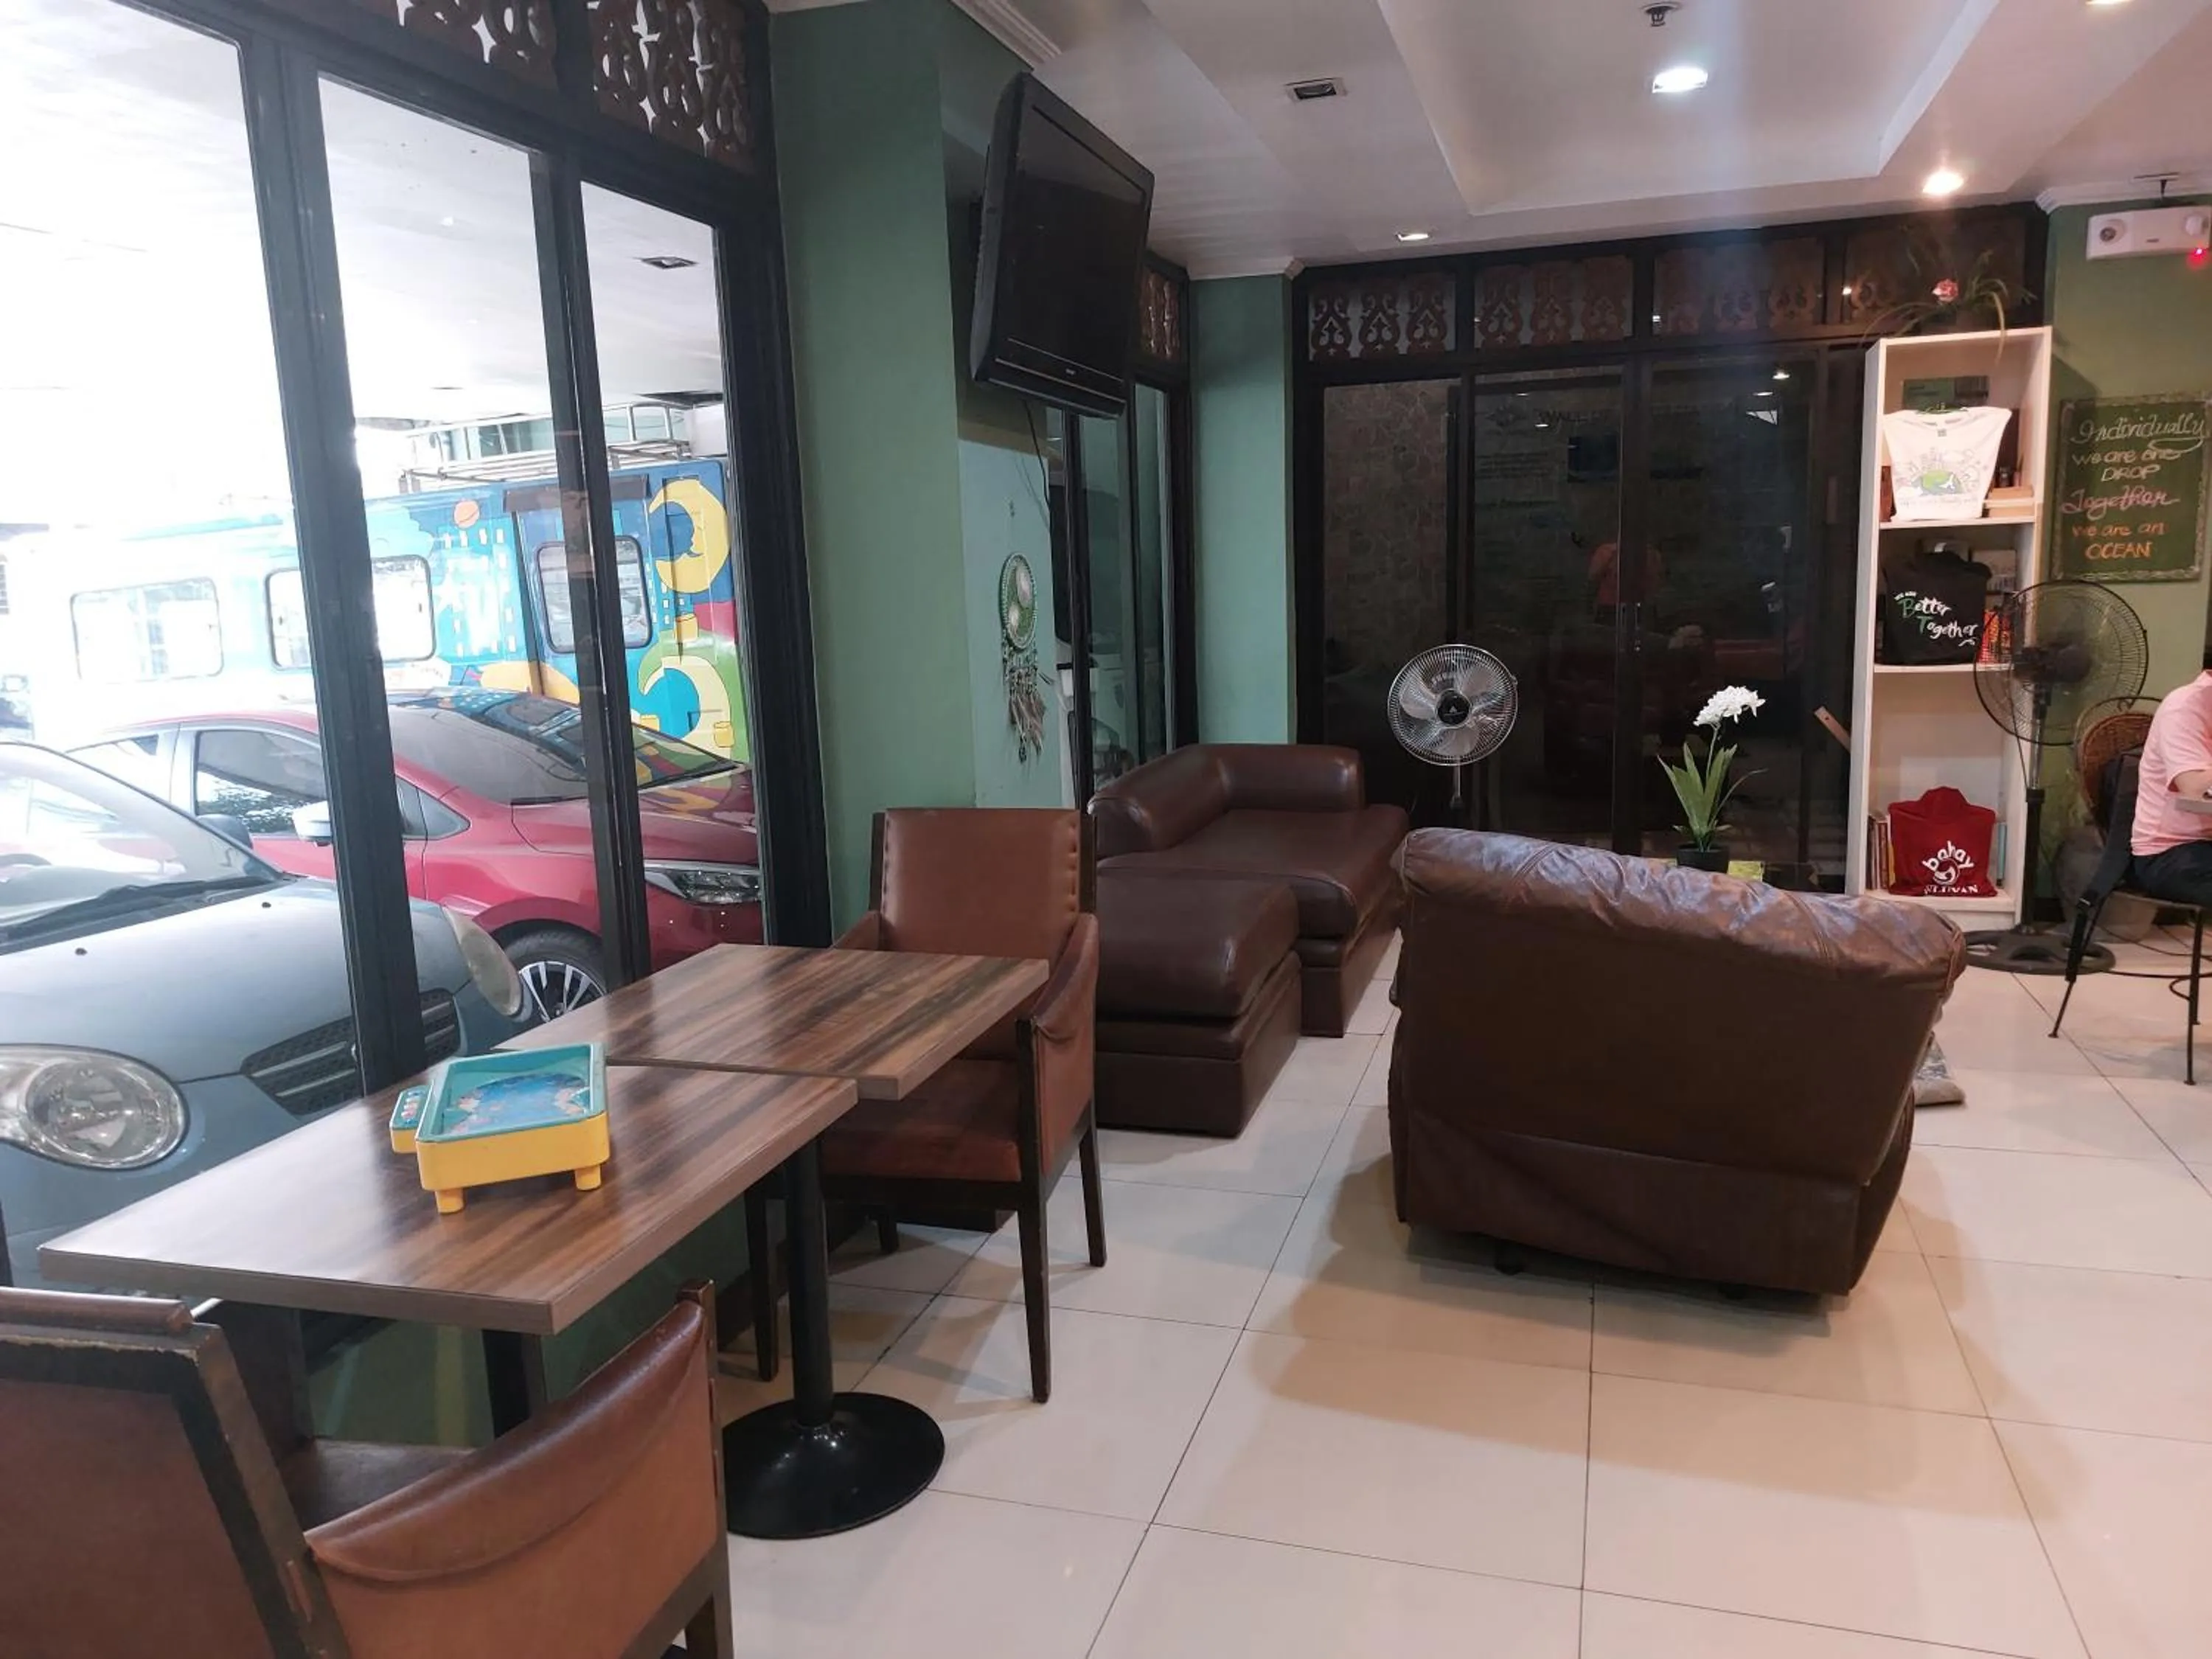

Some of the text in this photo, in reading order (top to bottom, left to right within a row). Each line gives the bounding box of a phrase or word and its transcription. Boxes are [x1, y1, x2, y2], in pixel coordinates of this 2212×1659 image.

[2070, 413, 2205, 444] Individually
[2103, 449, 2136, 463] are
[2101, 464, 2161, 481] DROP
[2101, 525, 2132, 537] are
[2138, 522, 2166, 535] an
[2085, 540, 2152, 560] OCEAN
[1898, 597, 1952, 619] Better
[1916, 615, 1978, 639] Together
[1921, 840, 1975, 872] bahay
